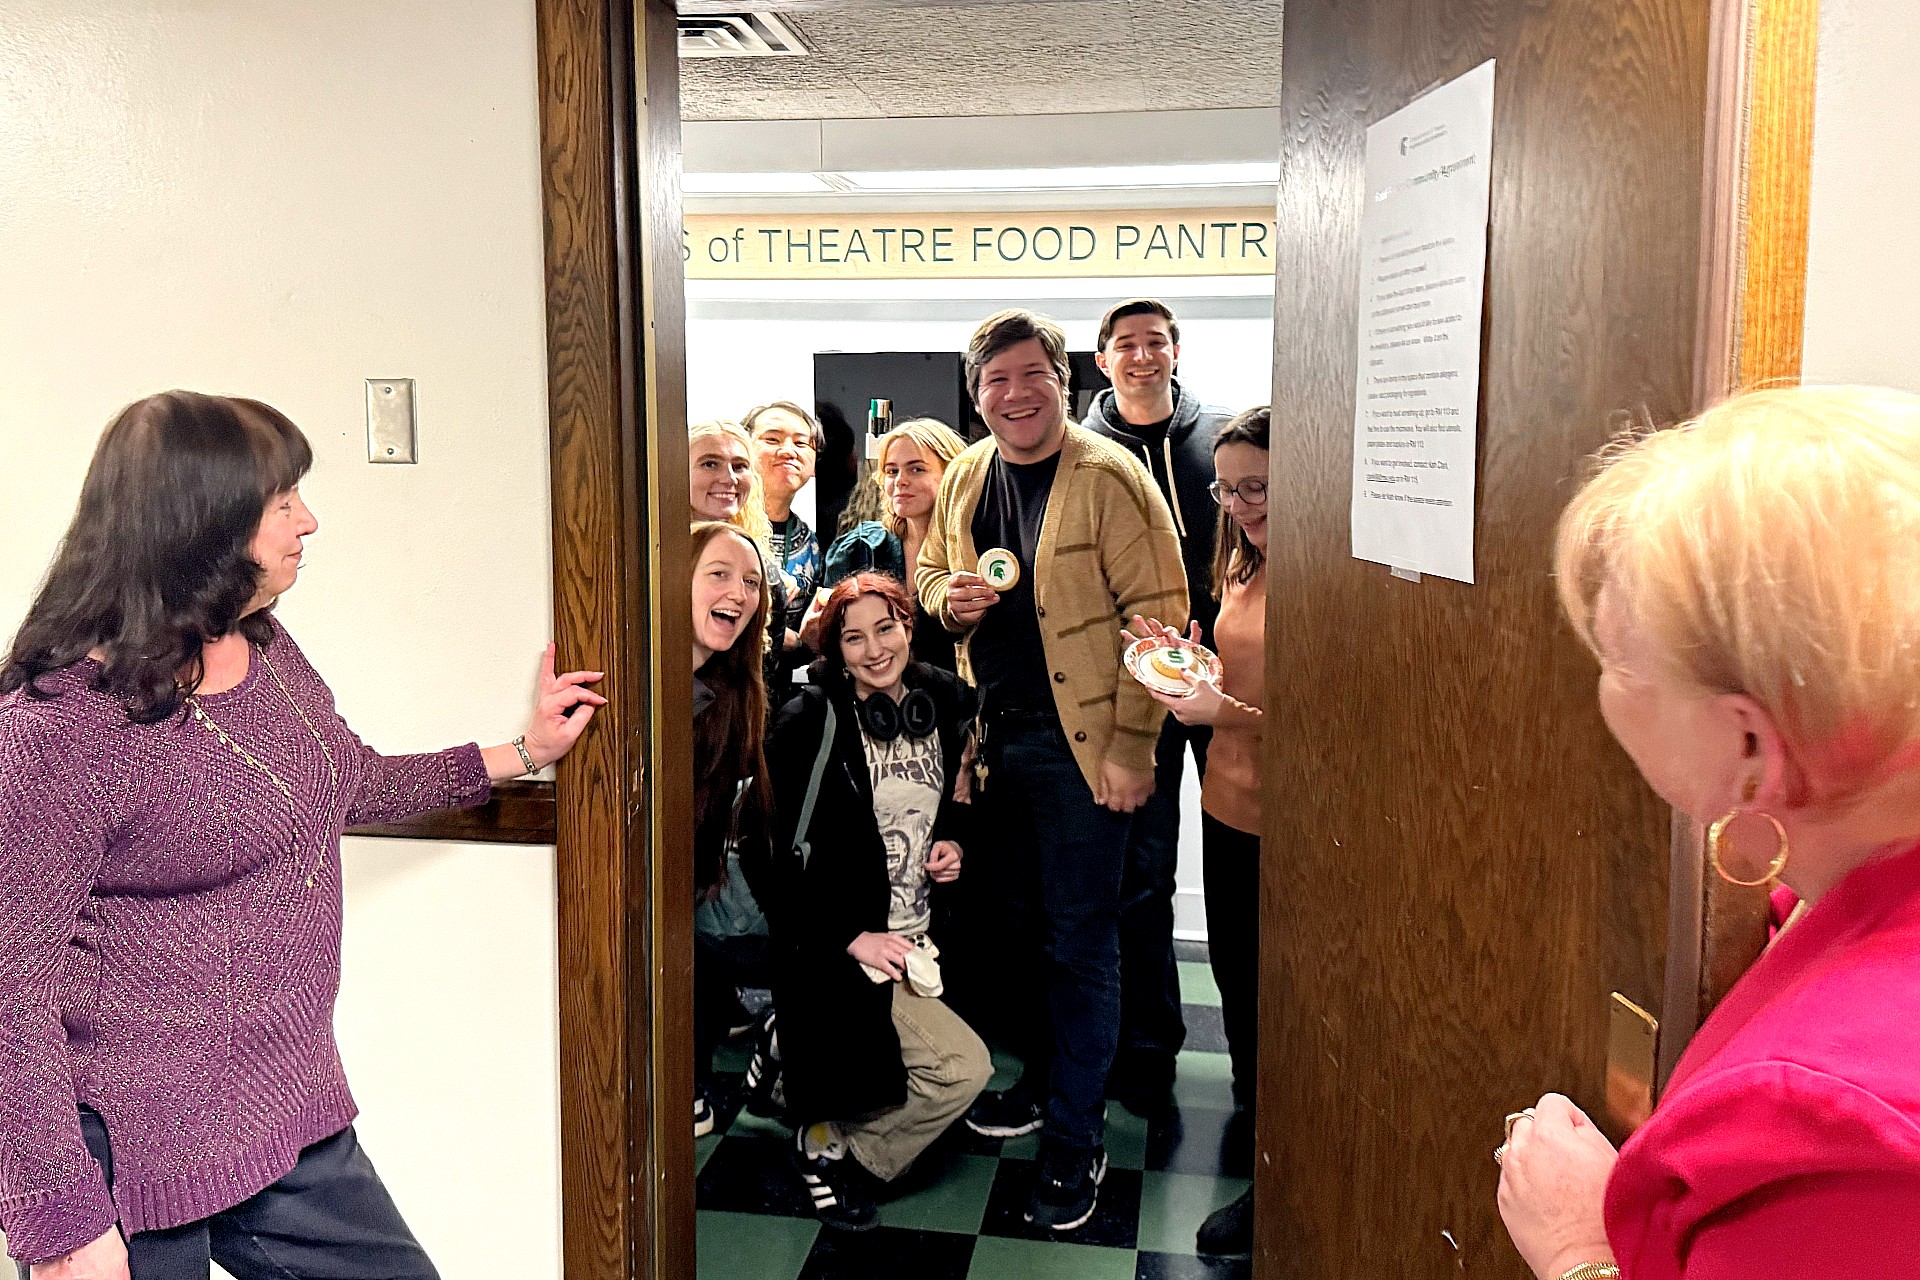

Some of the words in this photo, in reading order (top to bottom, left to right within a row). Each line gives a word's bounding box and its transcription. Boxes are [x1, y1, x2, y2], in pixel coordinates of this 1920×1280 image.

[708, 227, 744, 263] of
[758, 228, 954, 263] THEATRE
[973, 226, 1096, 262] FOOD
[1116, 222, 1277, 259] PANTR
